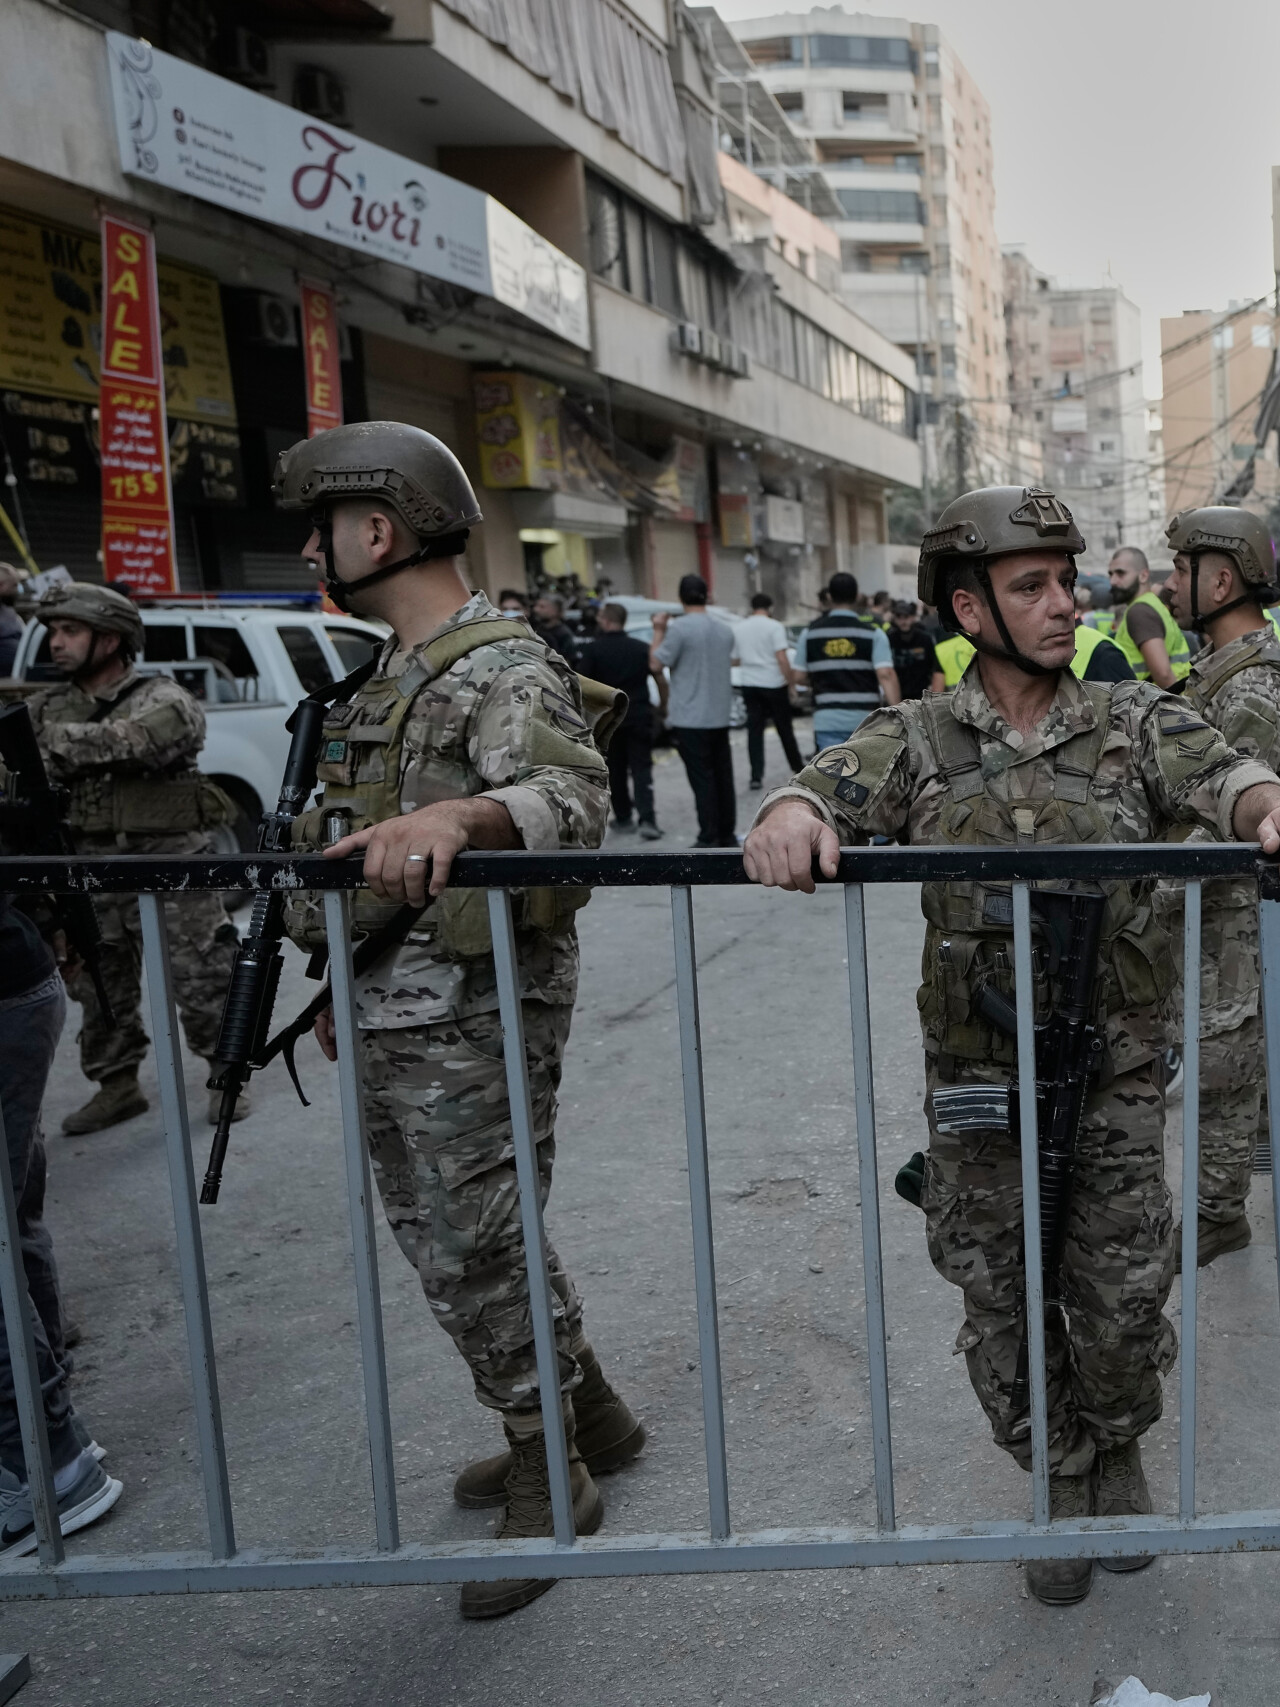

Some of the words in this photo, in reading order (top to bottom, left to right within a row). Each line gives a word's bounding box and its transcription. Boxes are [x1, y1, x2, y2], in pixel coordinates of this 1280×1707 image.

[292, 126, 421, 247] Fiori
[41, 230, 87, 274] MK
[109, 233, 142, 371] SALE
[310, 294, 331, 408] SALE
